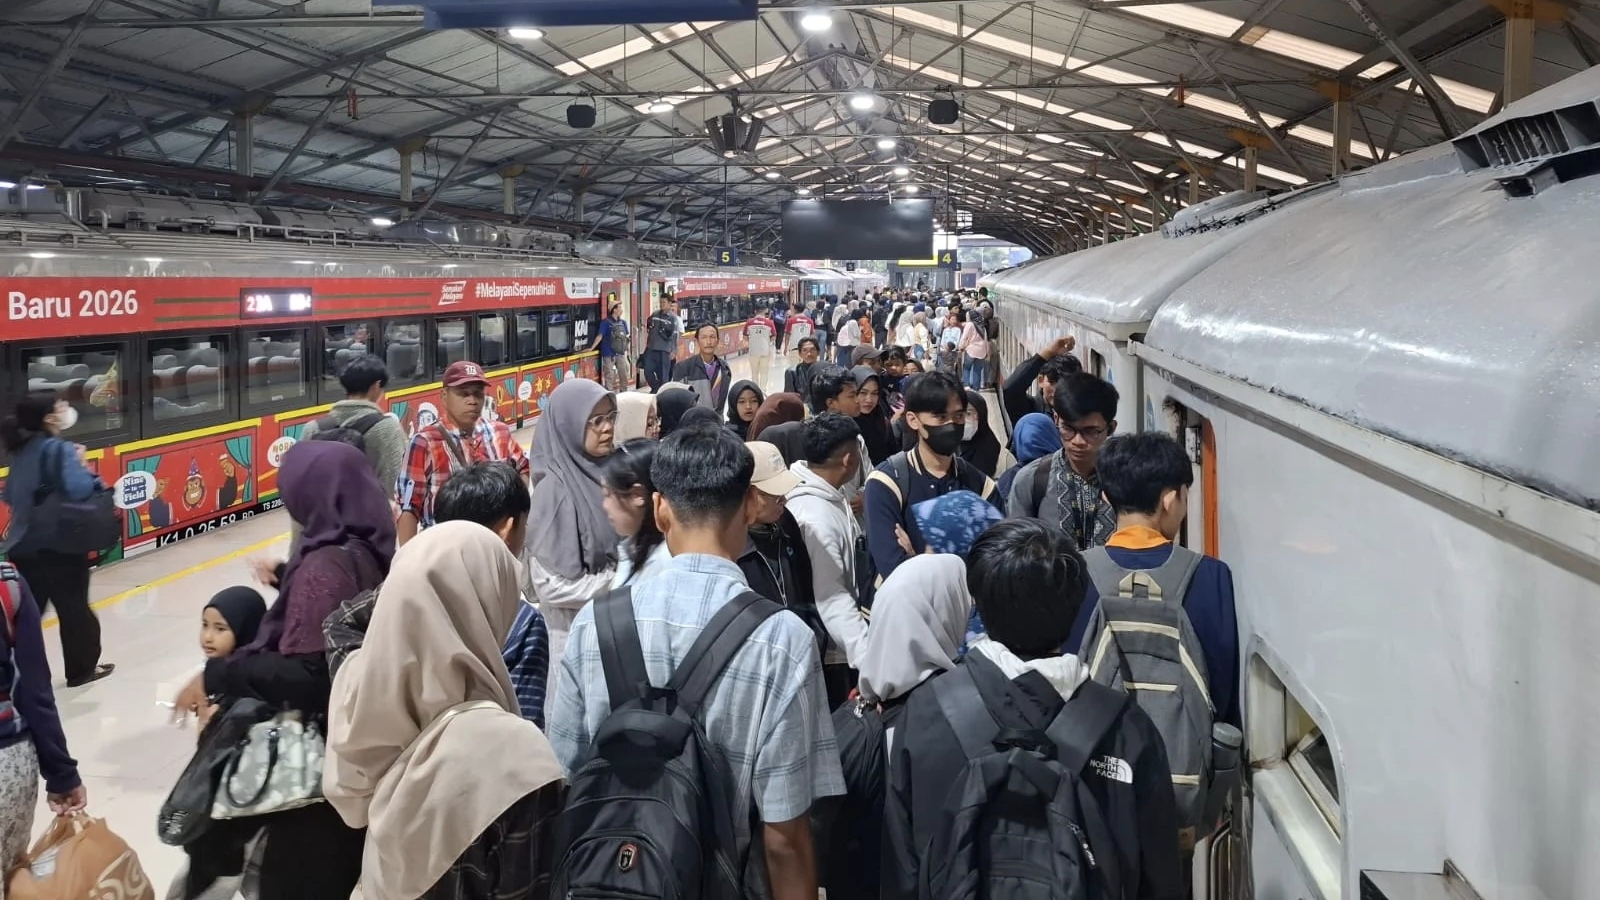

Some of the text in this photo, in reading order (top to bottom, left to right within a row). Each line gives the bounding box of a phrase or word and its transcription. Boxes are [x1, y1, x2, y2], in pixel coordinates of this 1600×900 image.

[722, 252, 730, 262] 5
[942, 252, 952, 264] 4
[8, 289, 138, 320] Baru 2026
[263, 501, 271, 511] TS
[1104, 755, 1119, 765] THE
[1090, 760, 1118, 772] NORTH
[1096, 769, 1117, 780] FACE
